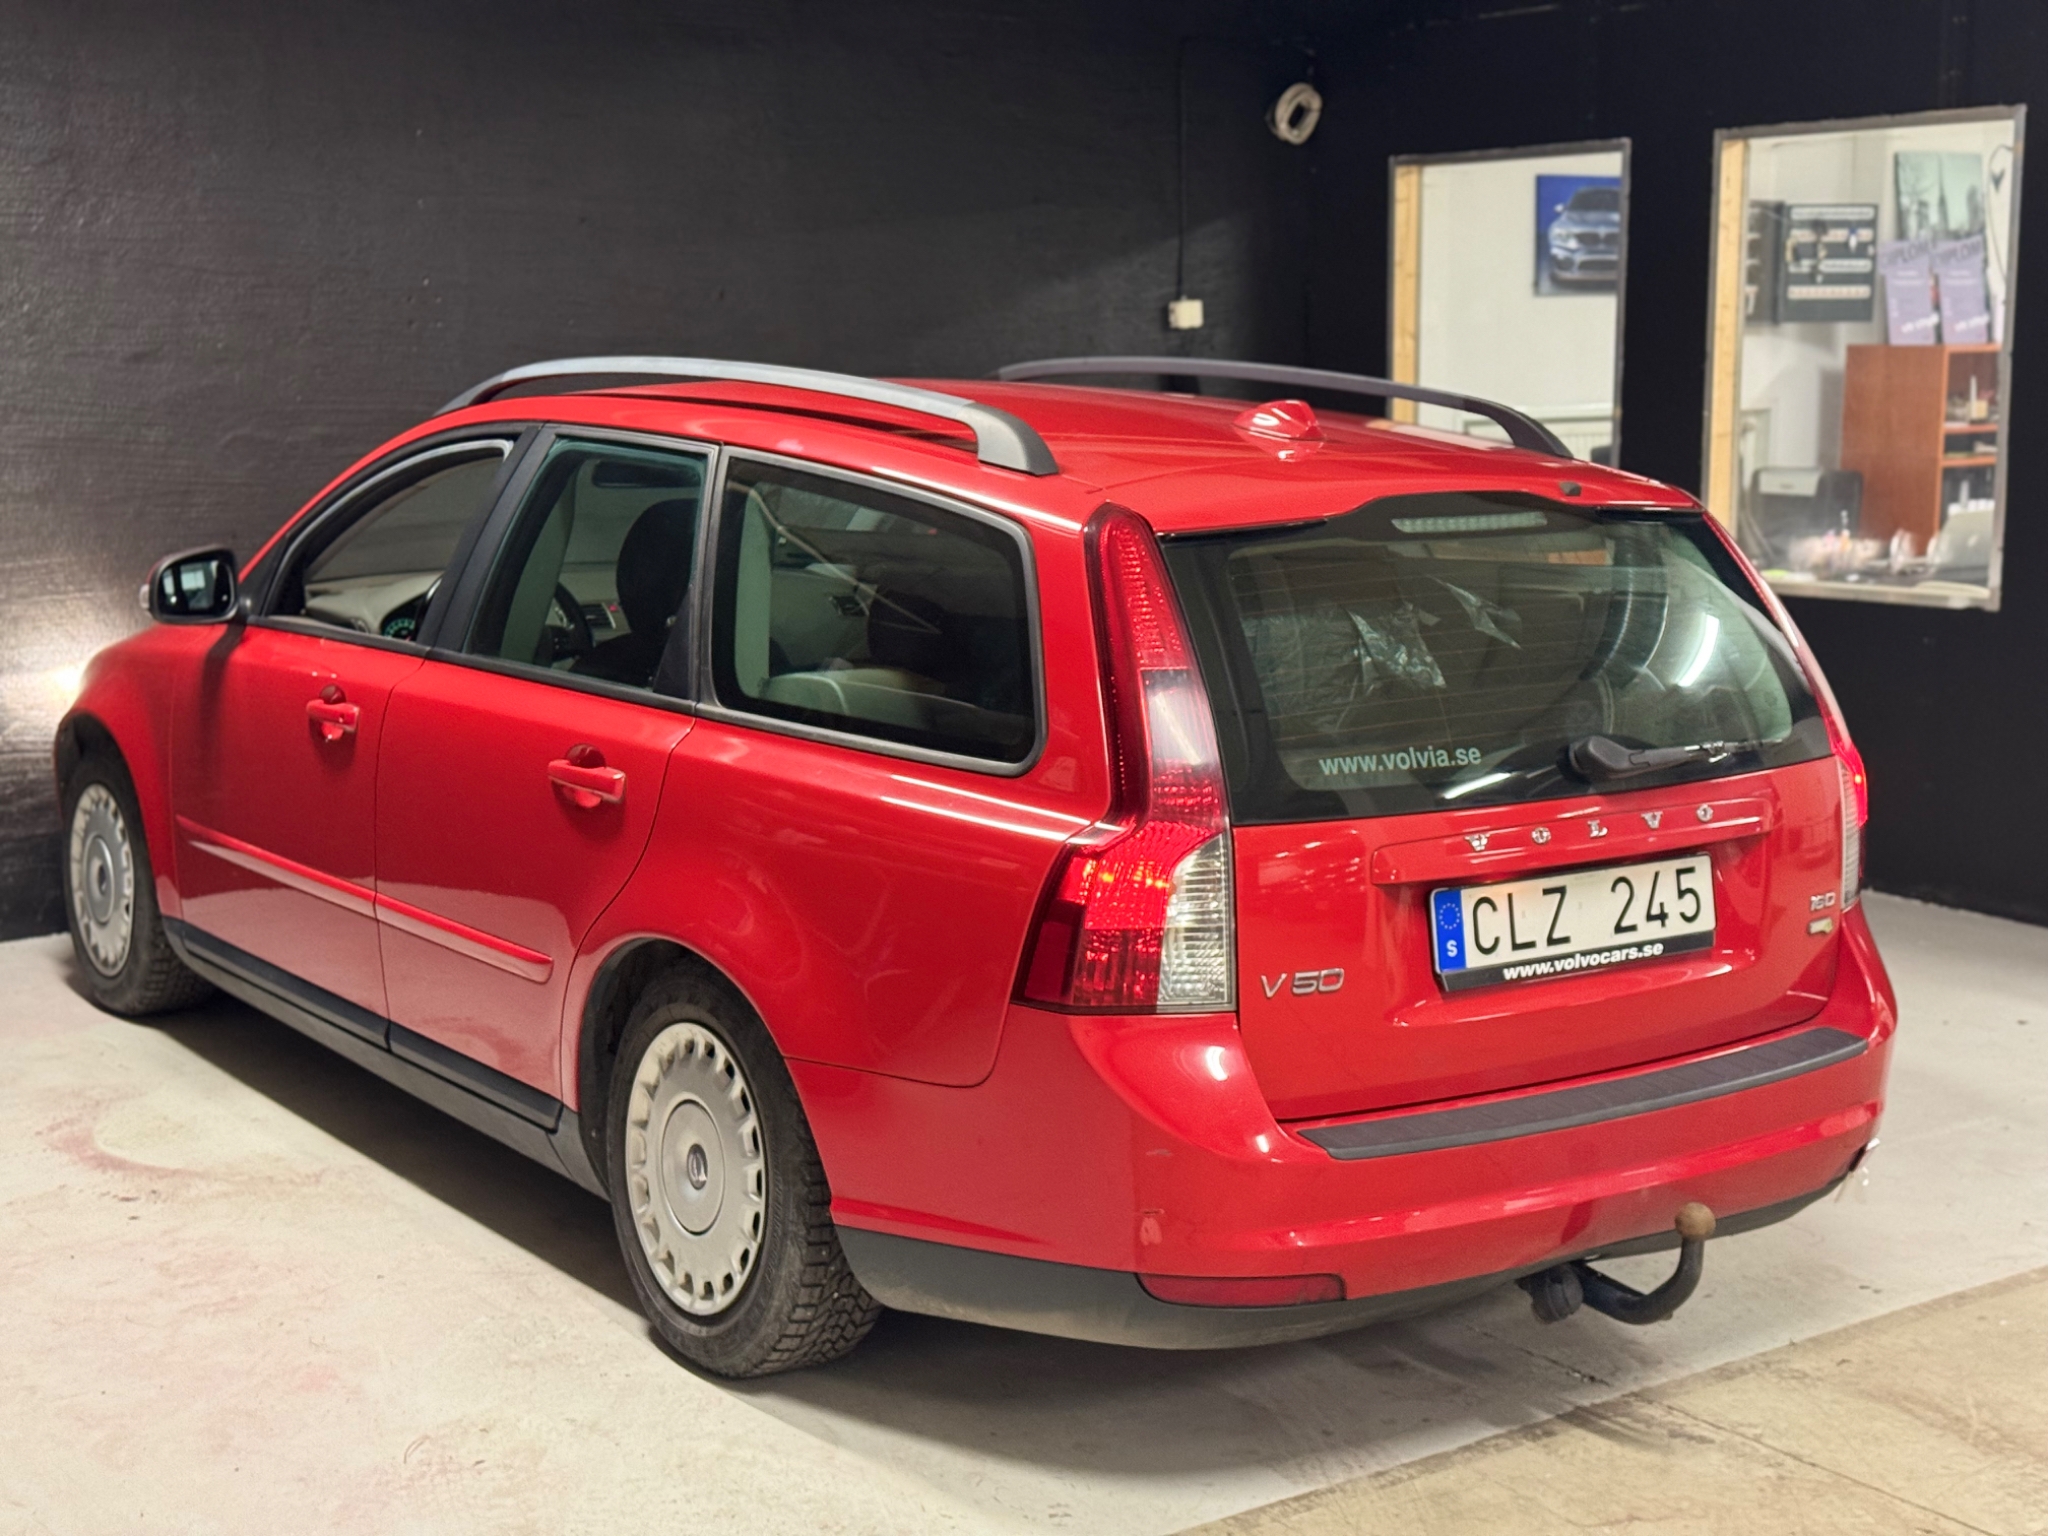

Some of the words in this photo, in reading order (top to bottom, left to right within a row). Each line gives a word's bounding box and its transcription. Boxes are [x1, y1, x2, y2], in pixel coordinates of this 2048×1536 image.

[1318, 745, 1482, 776] www.volvia.se
[1464, 803, 1714, 852] VOLVO
[1472, 885, 1571, 956] CLZ
[1610, 866, 1702, 935] 245
[1446, 940, 1458, 958] S
[1502, 942, 1664, 981] www.volvocars.se
